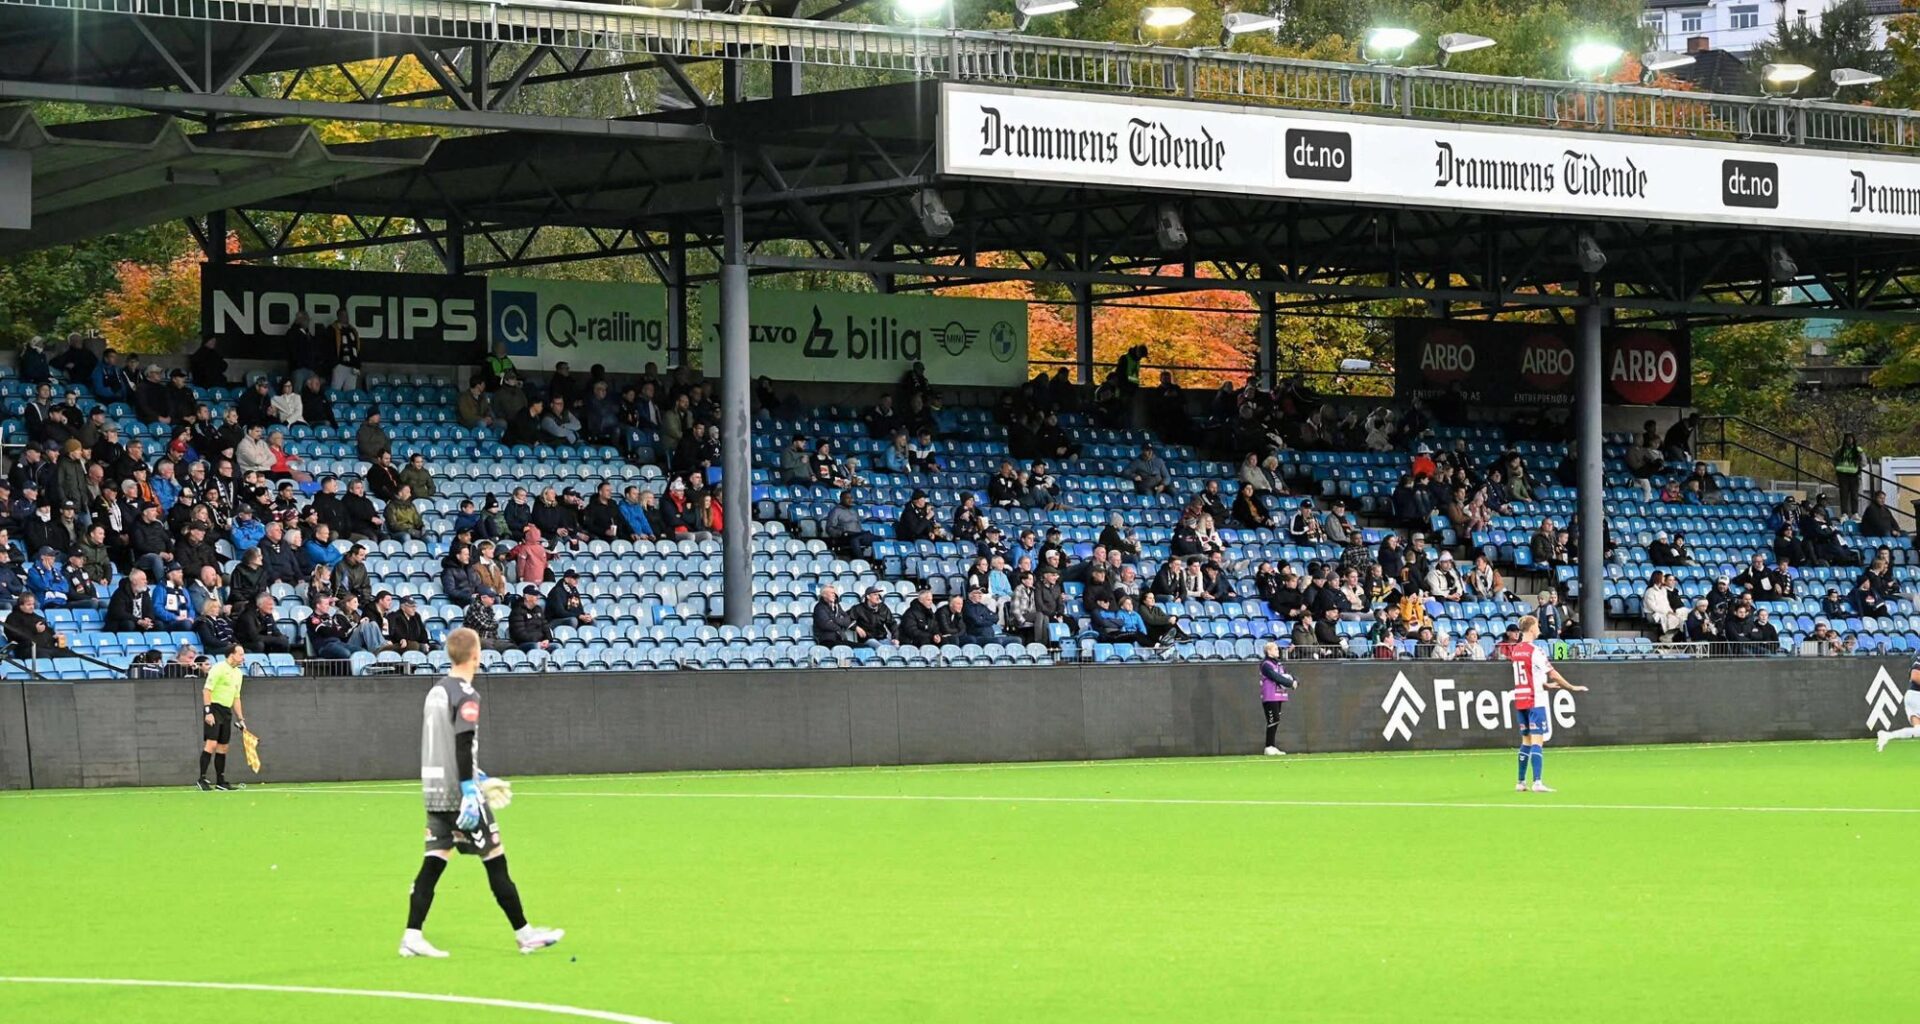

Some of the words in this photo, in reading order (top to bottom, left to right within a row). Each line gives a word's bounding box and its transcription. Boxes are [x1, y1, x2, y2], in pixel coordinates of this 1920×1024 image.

[979, 105, 1118, 164] Drammens
[1128, 117, 1226, 172] Tidende
[1293, 136, 1345, 169] dt.no
[1434, 140, 1555, 193] Drammens
[1562, 149, 1648, 199] Tidende
[1728, 172, 1773, 198] dt.no
[213, 289, 476, 341] NORGIPS
[501, 303, 529, 343] Q
[545, 303, 663, 351] Q-railing
[847, 315, 922, 361] bilia
[1420, 343, 1475, 372] ARBO
[1521, 347, 1574, 375] ARBO
[1610, 349, 1677, 384] ARBO
[1558, 646, 1564, 661] 3
[1512, 660, 1528, 686] 15
